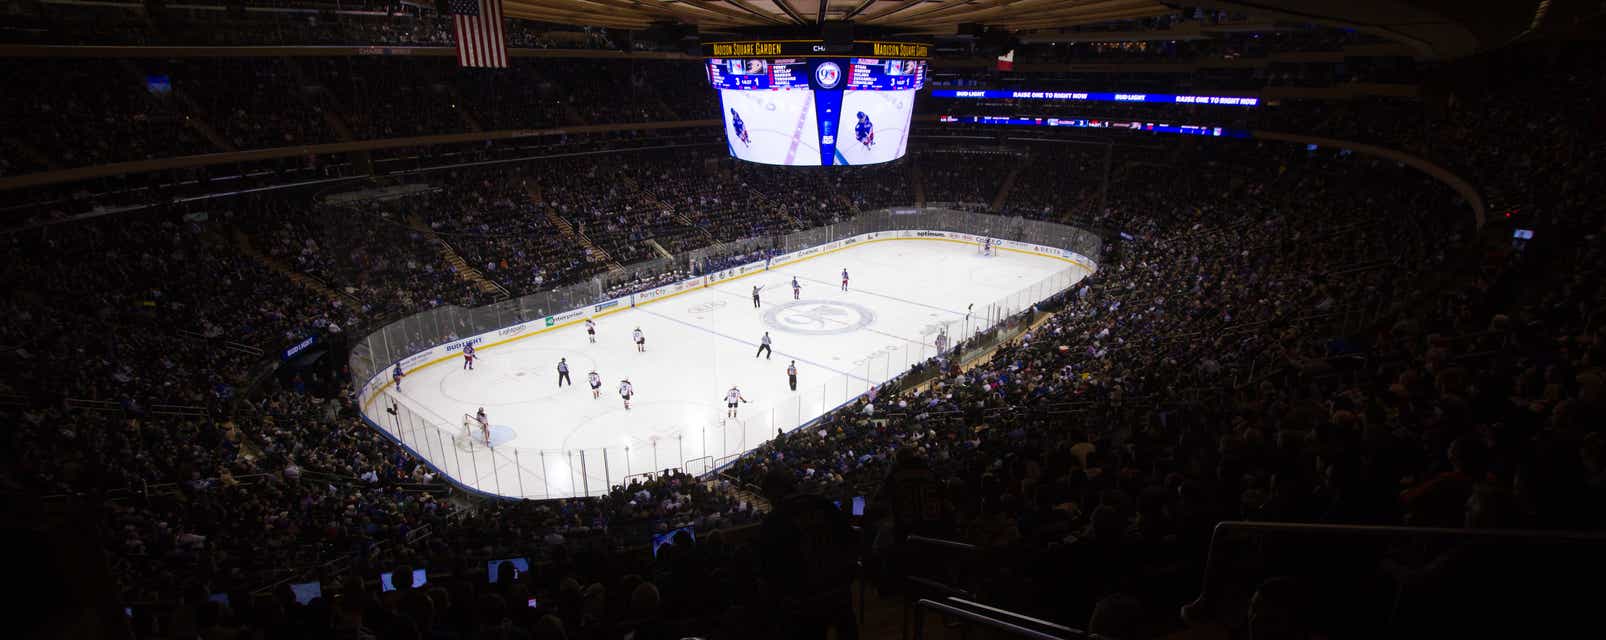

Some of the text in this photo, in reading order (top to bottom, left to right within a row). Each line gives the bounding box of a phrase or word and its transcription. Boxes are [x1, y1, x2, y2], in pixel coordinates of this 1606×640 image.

[734, 42, 754, 56] SQUARE
[755, 42, 782, 55] GARDEN
[874, 43, 899, 56] MADISON
[735, 77, 741, 86] 3
[891, 77, 896, 86] 3
[447, 343, 462, 352] BUD
